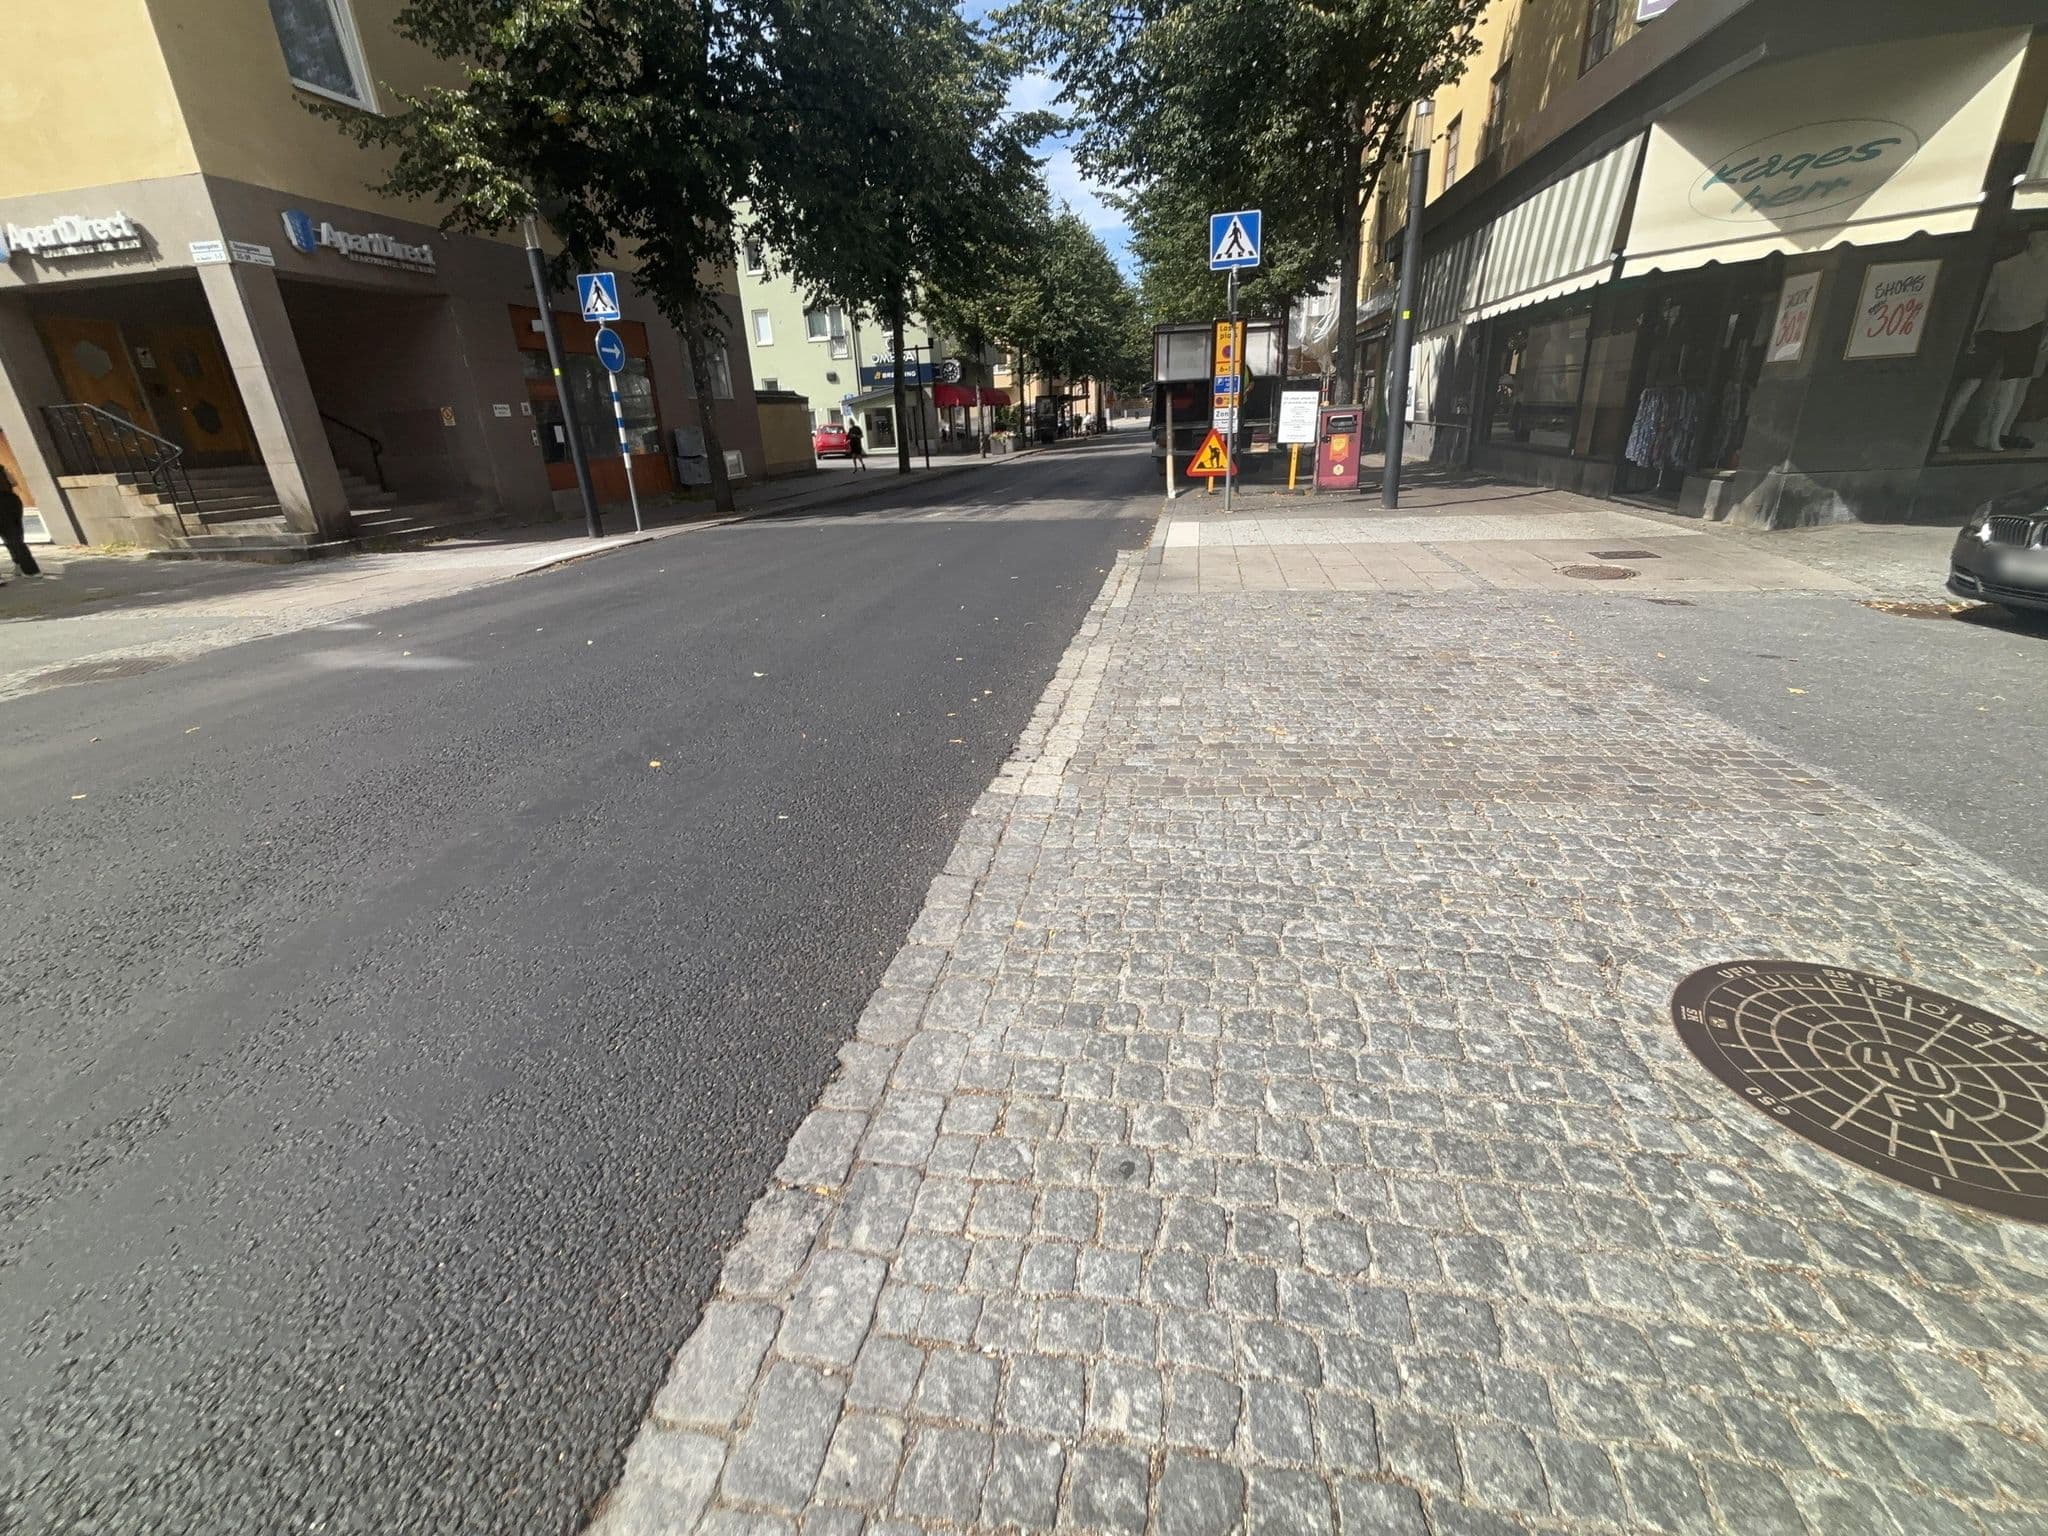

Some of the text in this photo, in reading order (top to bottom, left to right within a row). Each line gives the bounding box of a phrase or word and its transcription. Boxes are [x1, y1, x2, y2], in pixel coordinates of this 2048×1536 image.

[6, 210, 138, 254] ApartDirect
[320, 222, 435, 265] ApartDirect
[1866, 298, 1924, 338] 30%
[872, 351, 914, 363] OMEA
[882, 370, 916, 378] BREING
[1864, 977, 1905, 993] 124
[1863, 1046, 1947, 1090] 40
[1744, 1086, 1792, 1116] 650
[1883, 1092, 1955, 1130] FV
